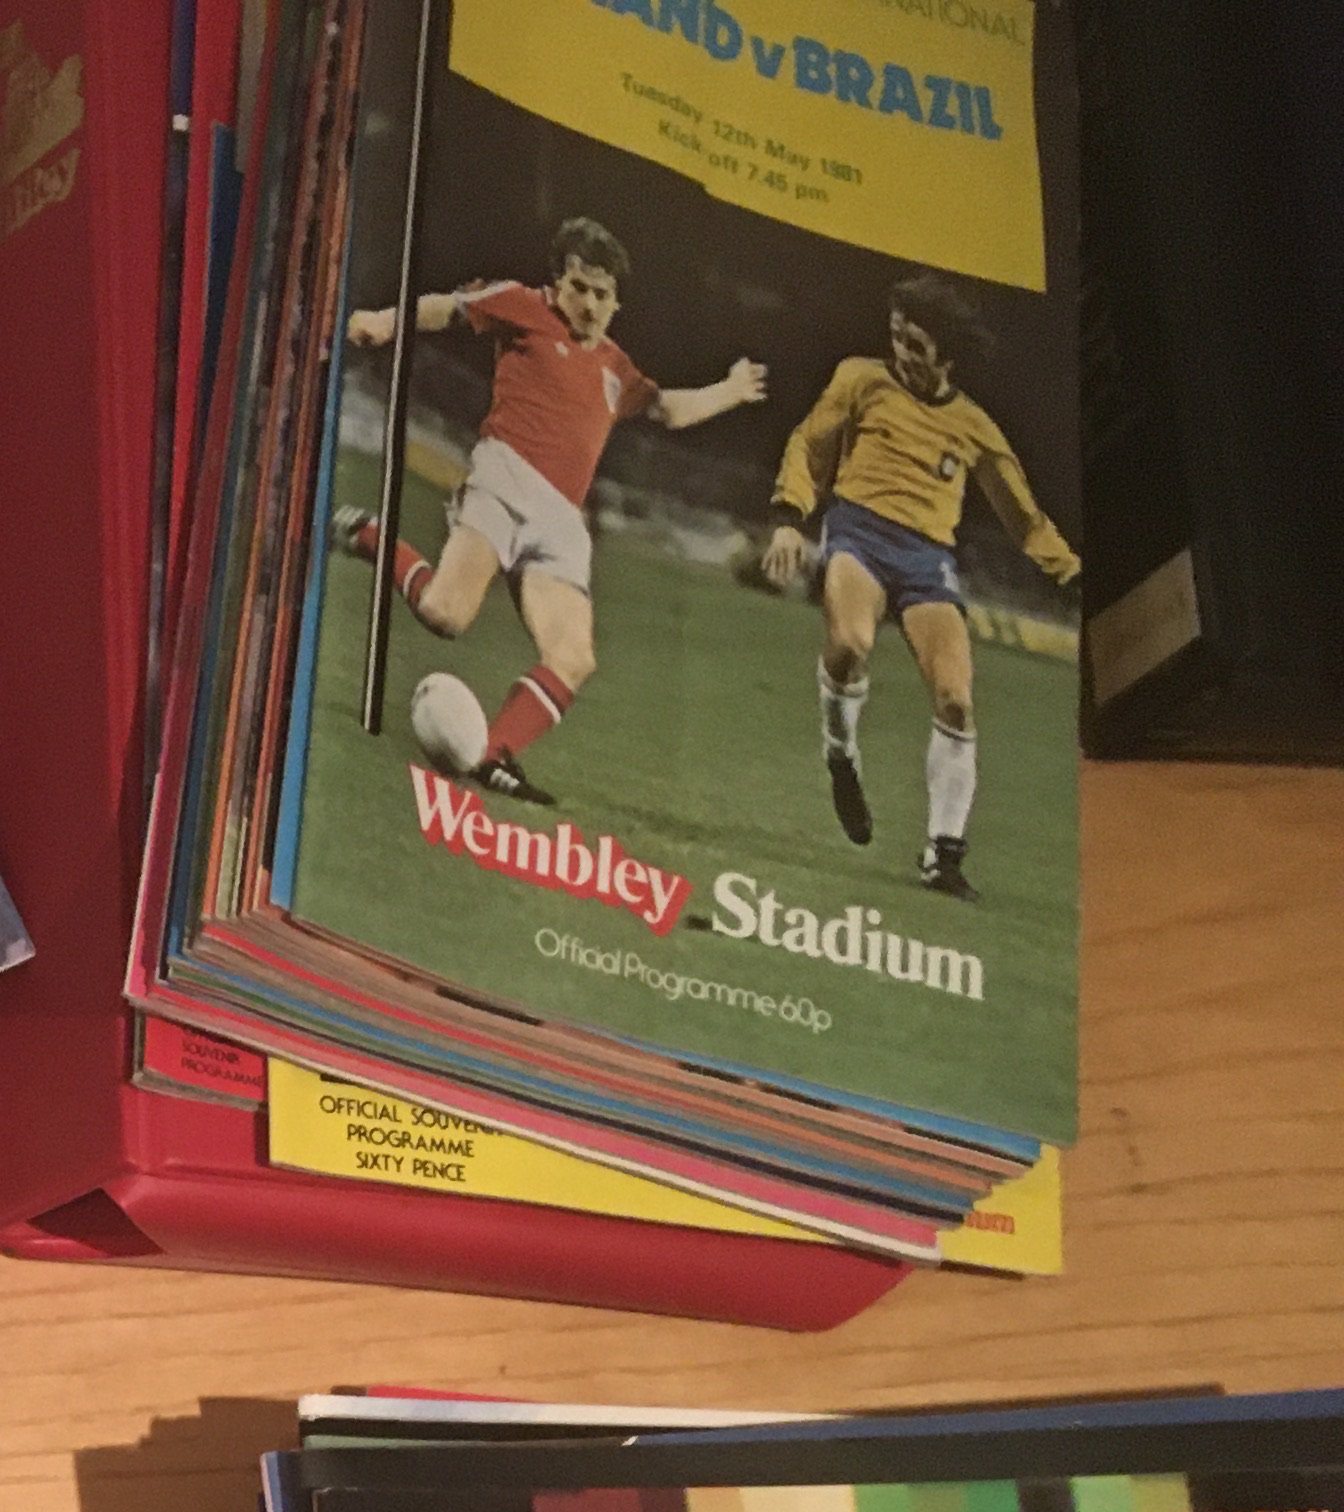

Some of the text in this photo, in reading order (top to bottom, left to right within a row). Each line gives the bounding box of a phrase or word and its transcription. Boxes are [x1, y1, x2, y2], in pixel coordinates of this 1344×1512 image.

[620, 72, 703, 124] Tuesday
[713, 120, 759, 149] 12th
[765, 139, 810, 171] May
[752, 35, 786, 79] v
[793, 35, 1002, 141] BRAZIL
[658, 119, 703, 154] Kick
[708, 152, 740, 174] off
[411, 764, 690, 932] Wembley
[534, 928, 832, 1034] Official Programme 60p
[712, 872, 986, 1001] Stadium
[319, 1094, 403, 1123] OFFICIAL
[346, 1124, 475, 1158] PROGRAMME
[355, 1150, 467, 1183] SIXTY PENCE
